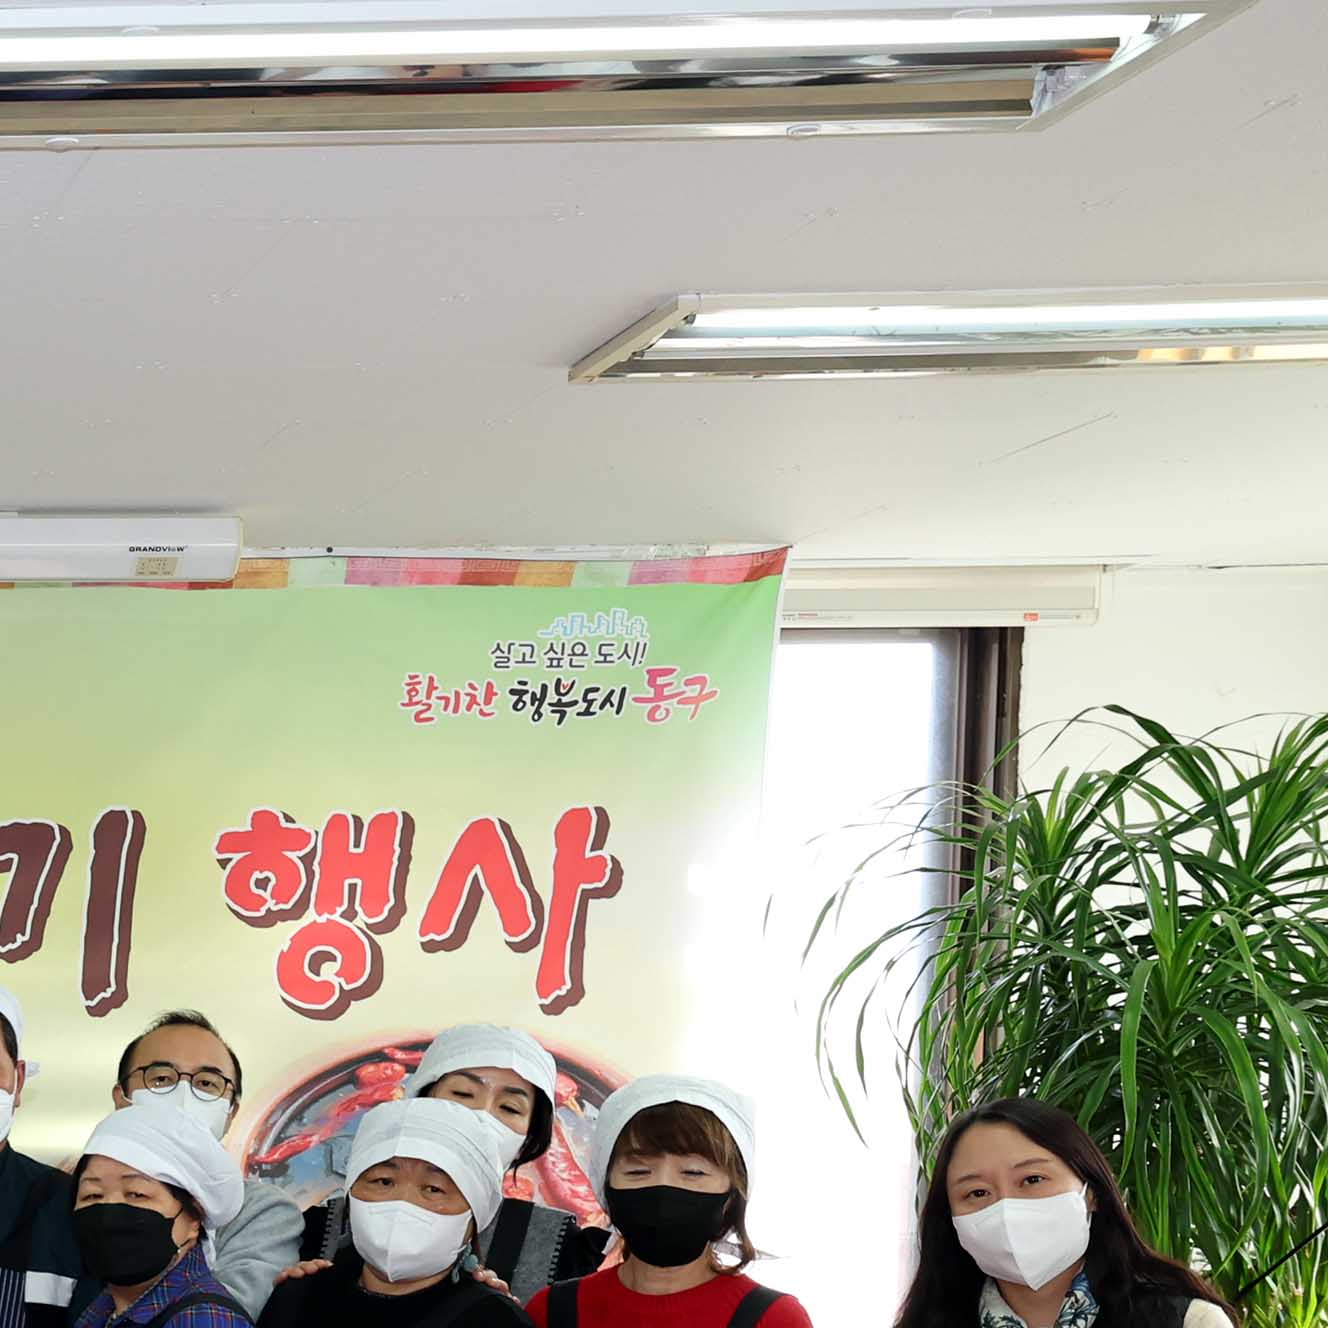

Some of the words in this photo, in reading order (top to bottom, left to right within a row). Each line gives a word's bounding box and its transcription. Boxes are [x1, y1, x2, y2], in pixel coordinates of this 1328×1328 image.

[492, 642, 536, 668] 살고
[544, 642, 588, 668] 싶은
[595, 643, 647, 666] 도시!
[401, 674, 498, 723] 활기찬
[508, 678, 626, 725] 행복도시
[632, 667, 717, 721] 동구
[216, 806, 624, 1020] 행사
